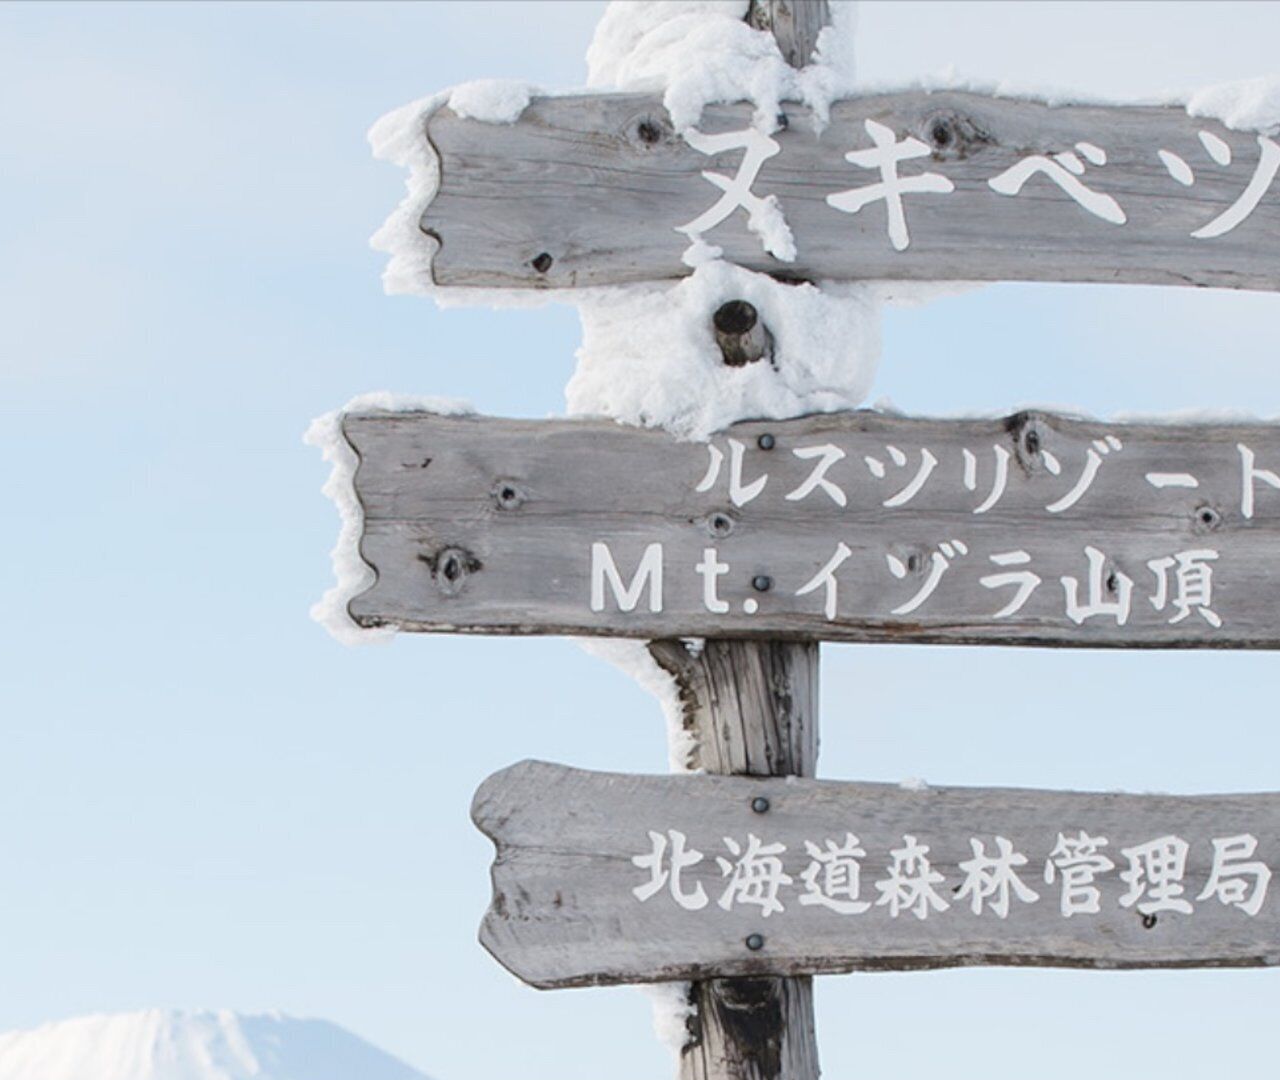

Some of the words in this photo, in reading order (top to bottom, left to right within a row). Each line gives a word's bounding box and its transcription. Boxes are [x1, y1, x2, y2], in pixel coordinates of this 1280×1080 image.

[631, 828, 1273, 920] 北海道森林管理局
